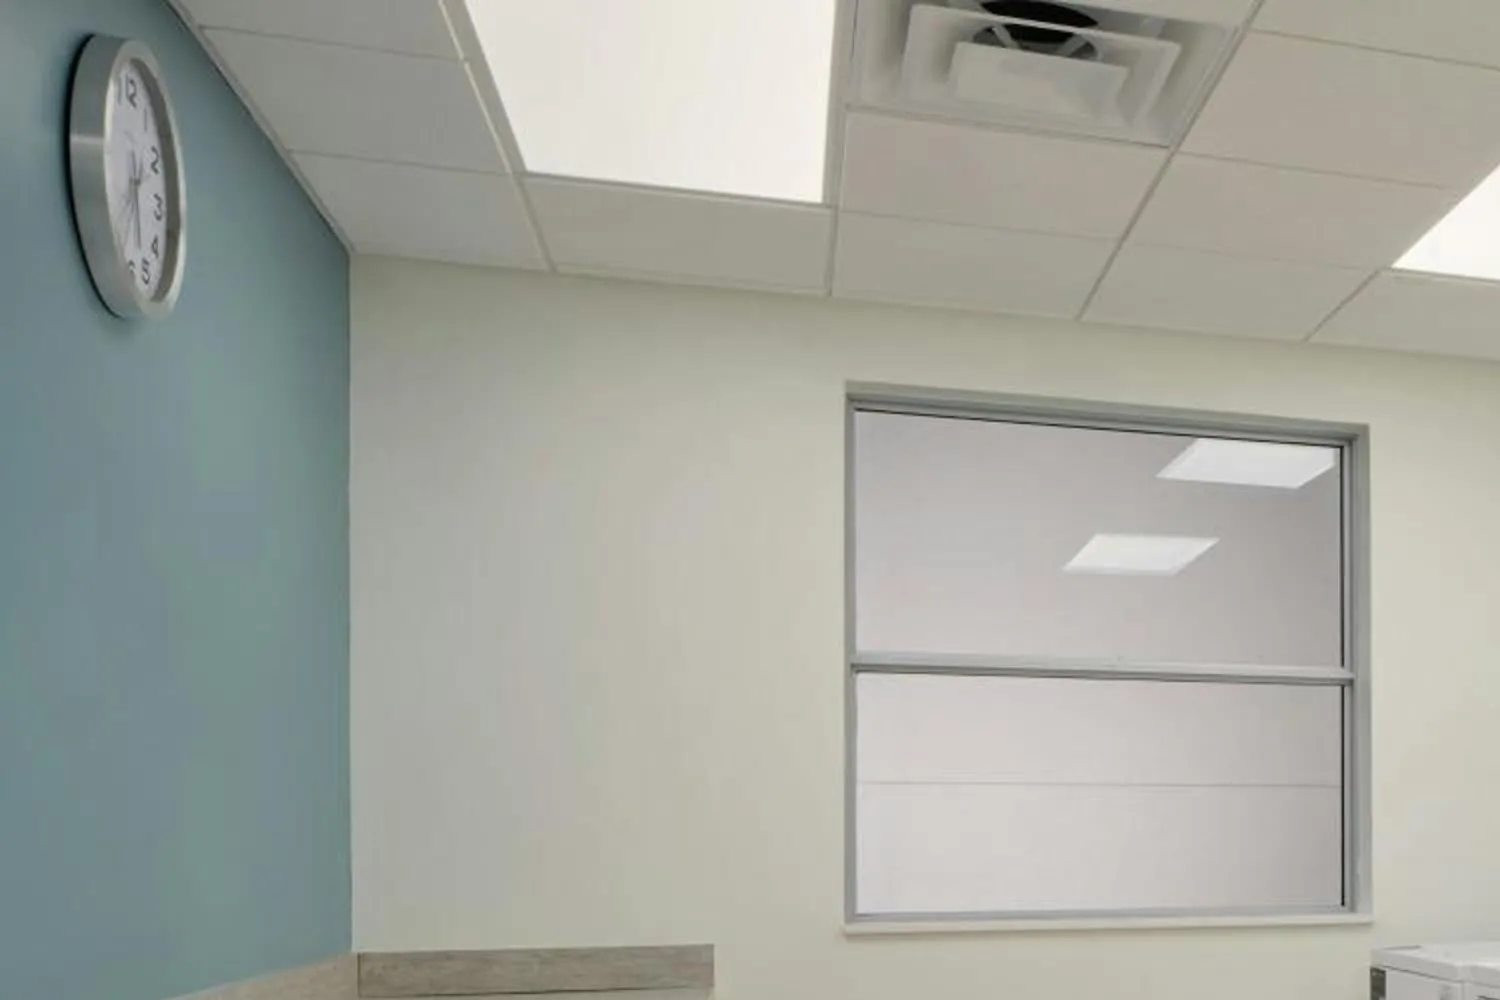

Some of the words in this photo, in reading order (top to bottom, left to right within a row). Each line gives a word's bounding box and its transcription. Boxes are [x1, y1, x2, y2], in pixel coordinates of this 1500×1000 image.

[151, 145, 160, 175] 2
[153, 193, 163, 222] 3
[151, 234, 160, 260] 4
[141, 257, 150, 285] 5
